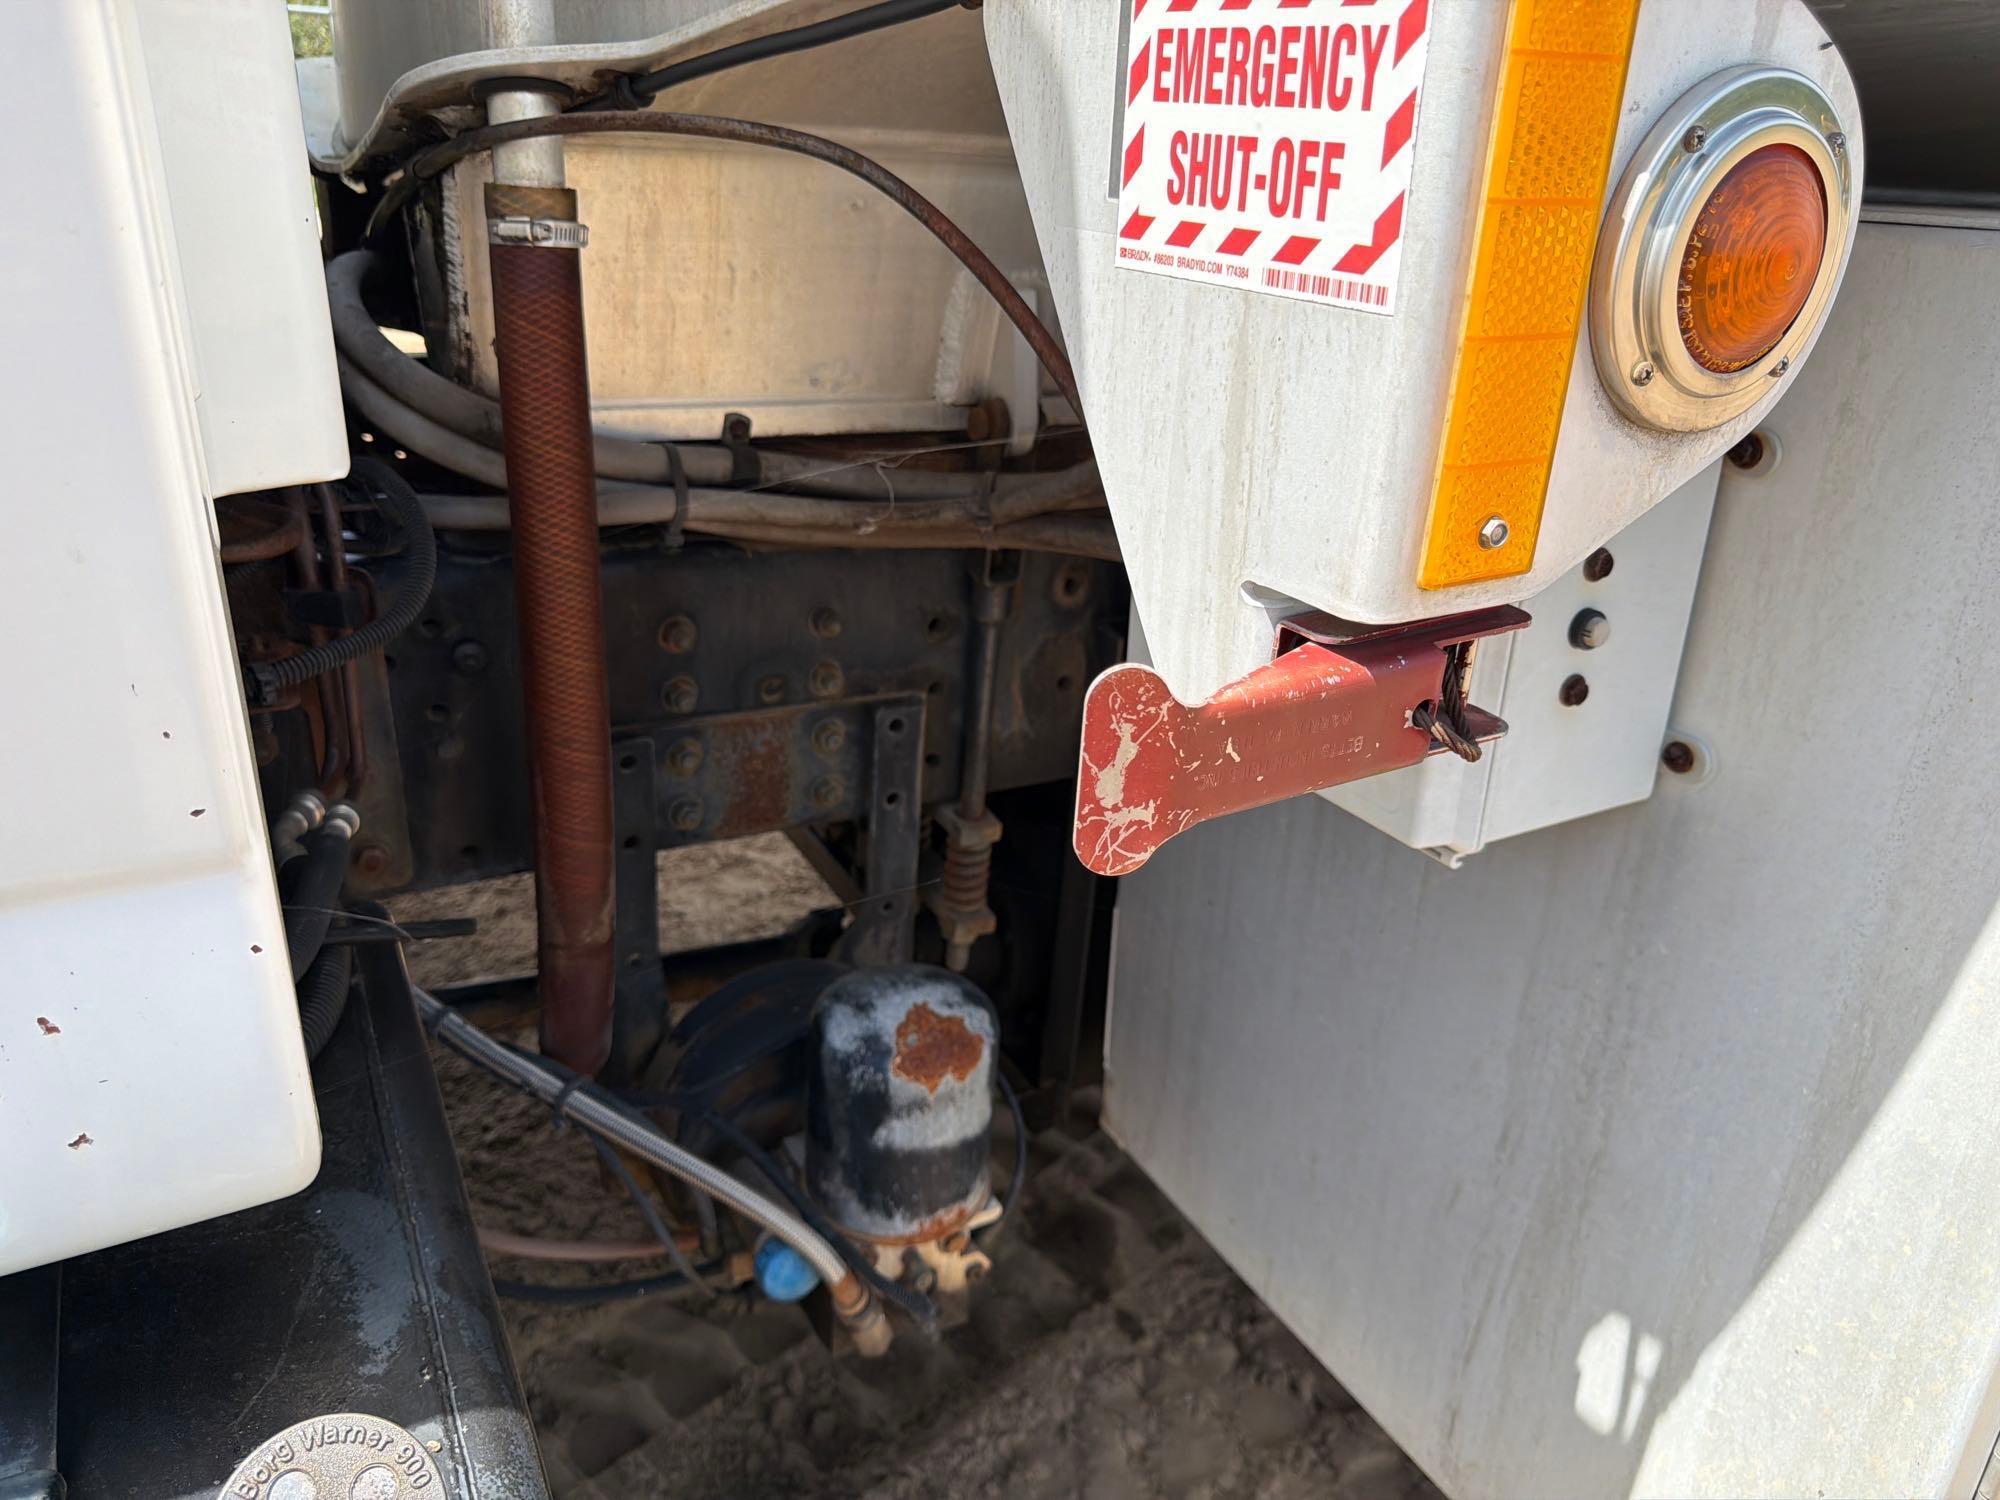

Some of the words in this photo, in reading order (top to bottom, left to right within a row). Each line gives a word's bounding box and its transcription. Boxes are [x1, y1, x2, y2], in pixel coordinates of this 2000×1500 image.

[1153, 23, 1390, 112] EMERGENCY
[1167, 130, 1346, 222] SHUT-OFF
[233, 1439, 296, 1500] Borg
[300, 1423, 394, 1451] Warner
[394, 1443, 433, 1490] 900
